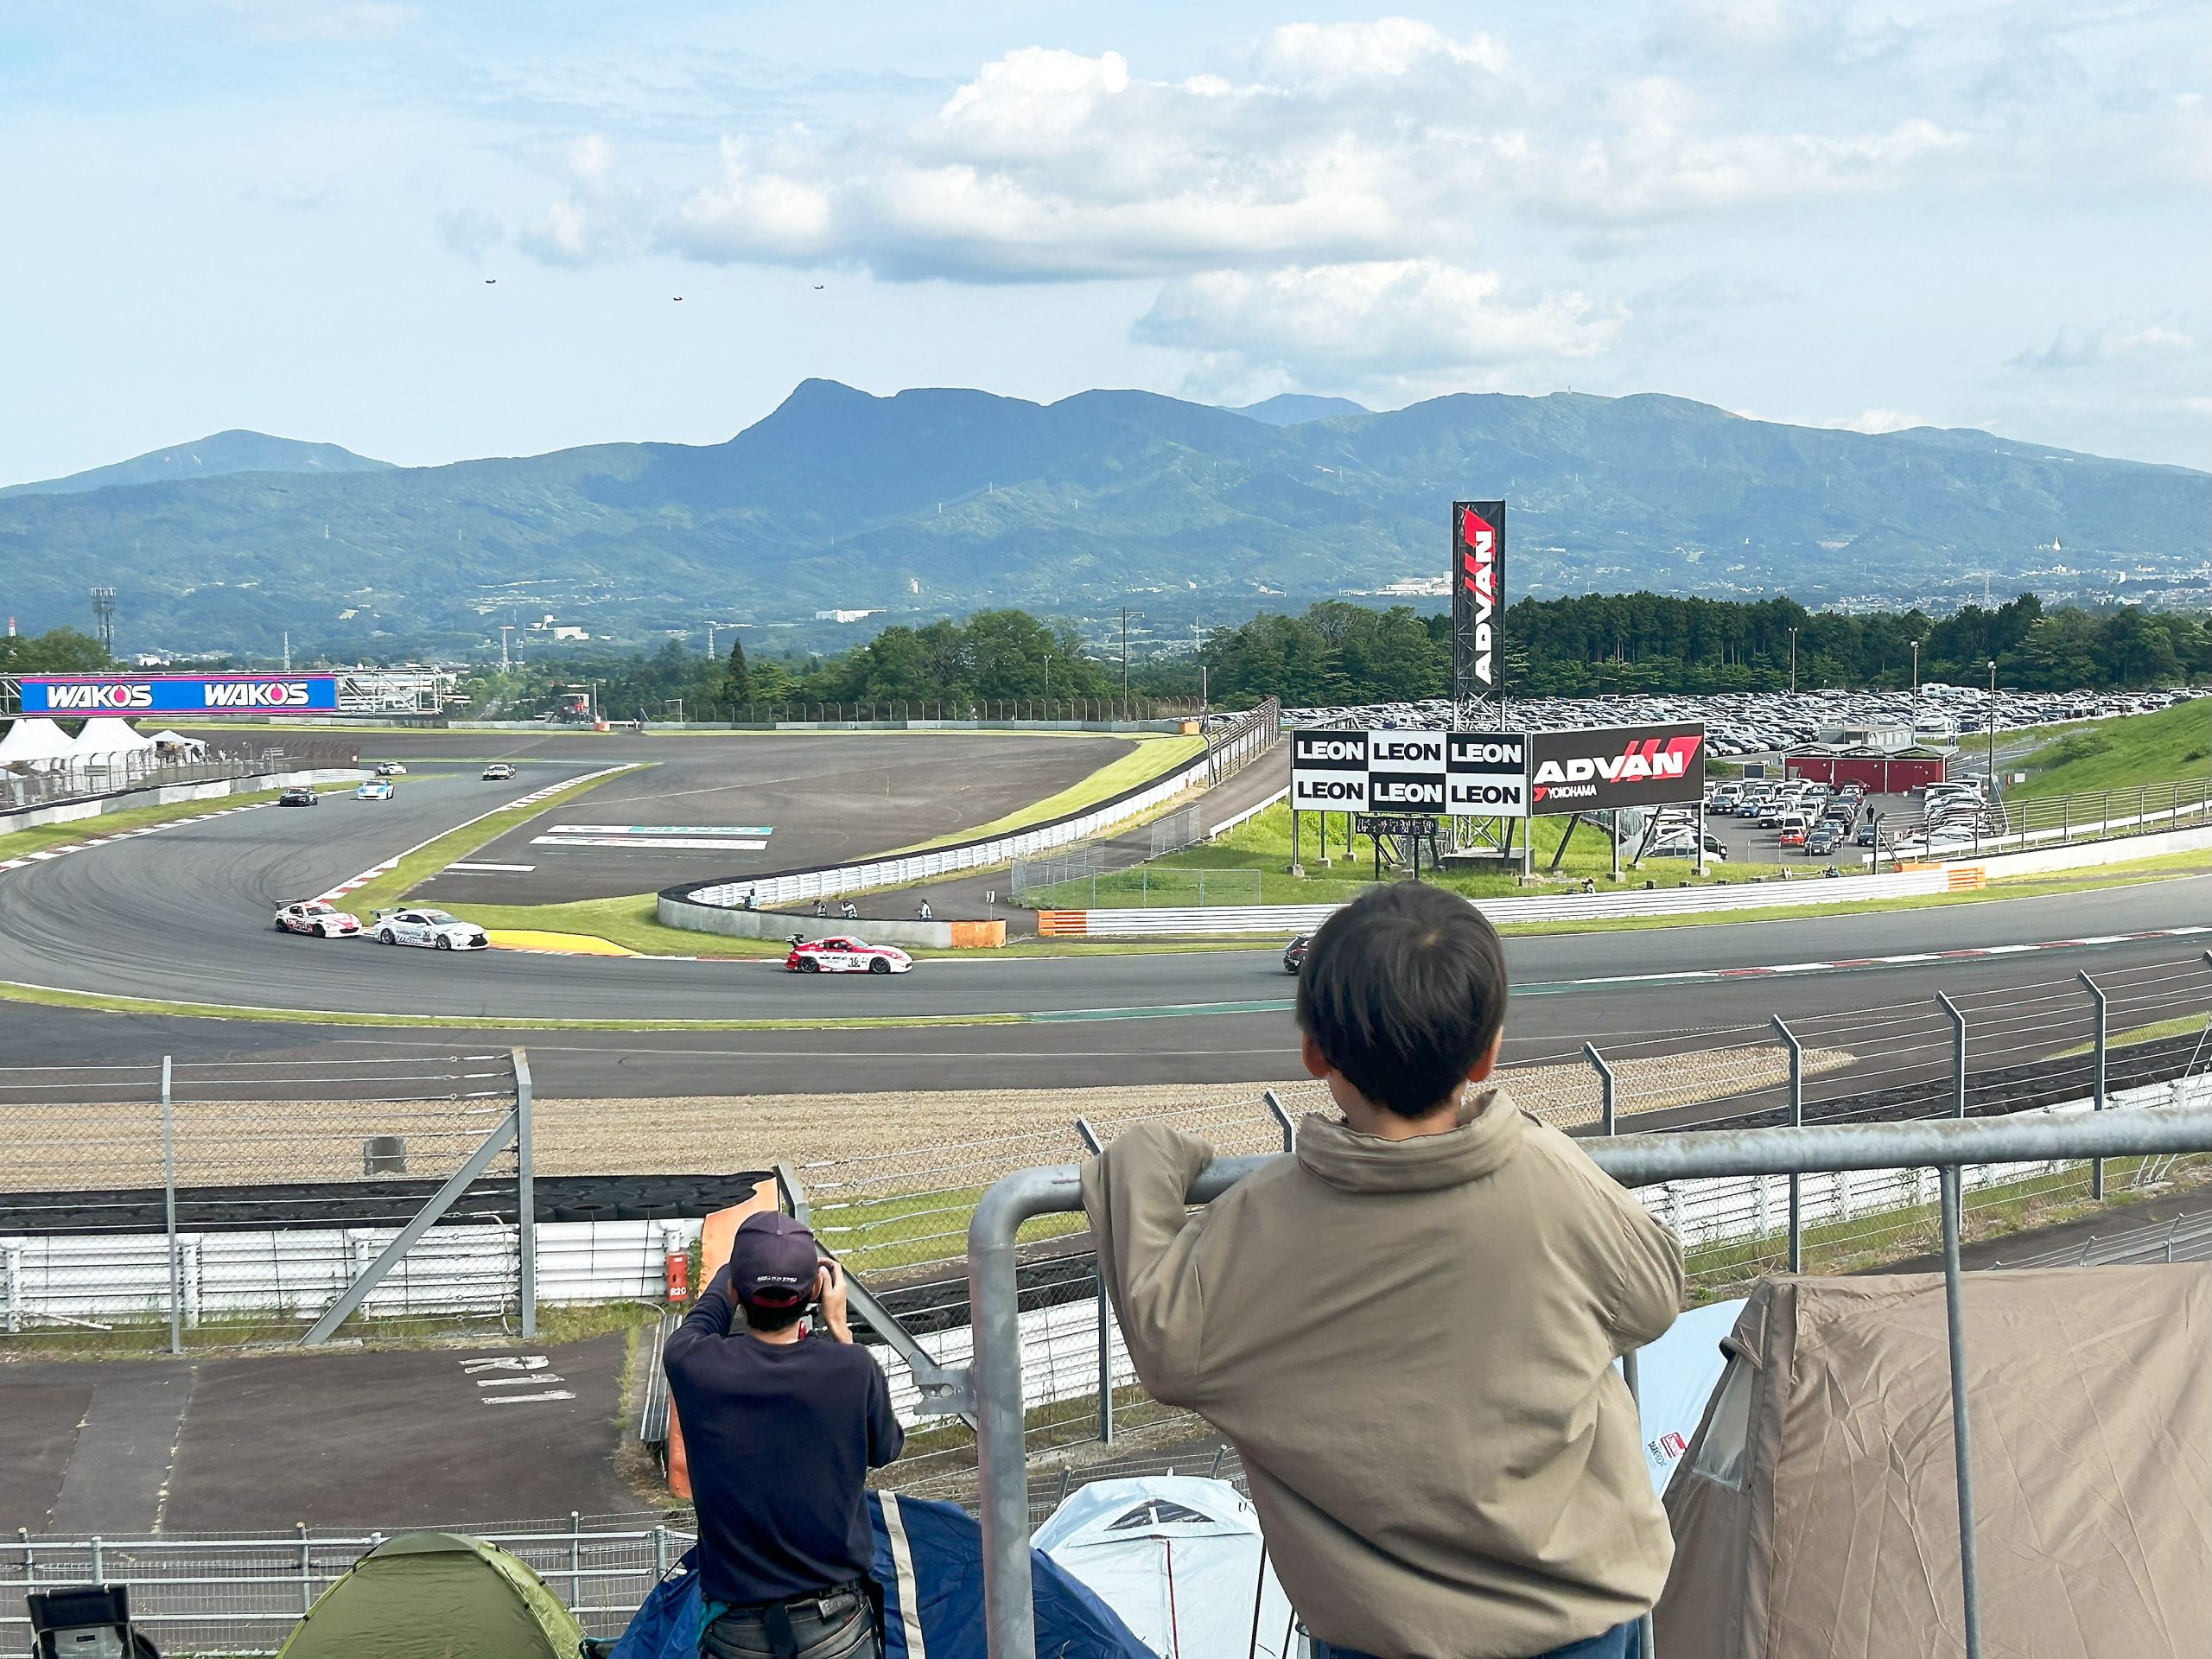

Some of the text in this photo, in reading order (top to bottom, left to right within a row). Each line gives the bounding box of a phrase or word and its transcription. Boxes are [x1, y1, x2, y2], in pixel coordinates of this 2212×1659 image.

[1476, 531, 1492, 686] ADVAN
[1297, 741, 1364, 760] LEON
[1373, 742, 1441, 761] LEON
[1451, 743, 1522, 764] LEON
[1532, 751, 1683, 785] ADVAN
[1298, 781, 1364, 800] LEON
[1374, 783, 1443, 804] LEON
[1451, 785, 1521, 804] LEON
[1548, 784, 1598, 800] YOKOHAMA
[670, 1287, 687, 1296] R20
